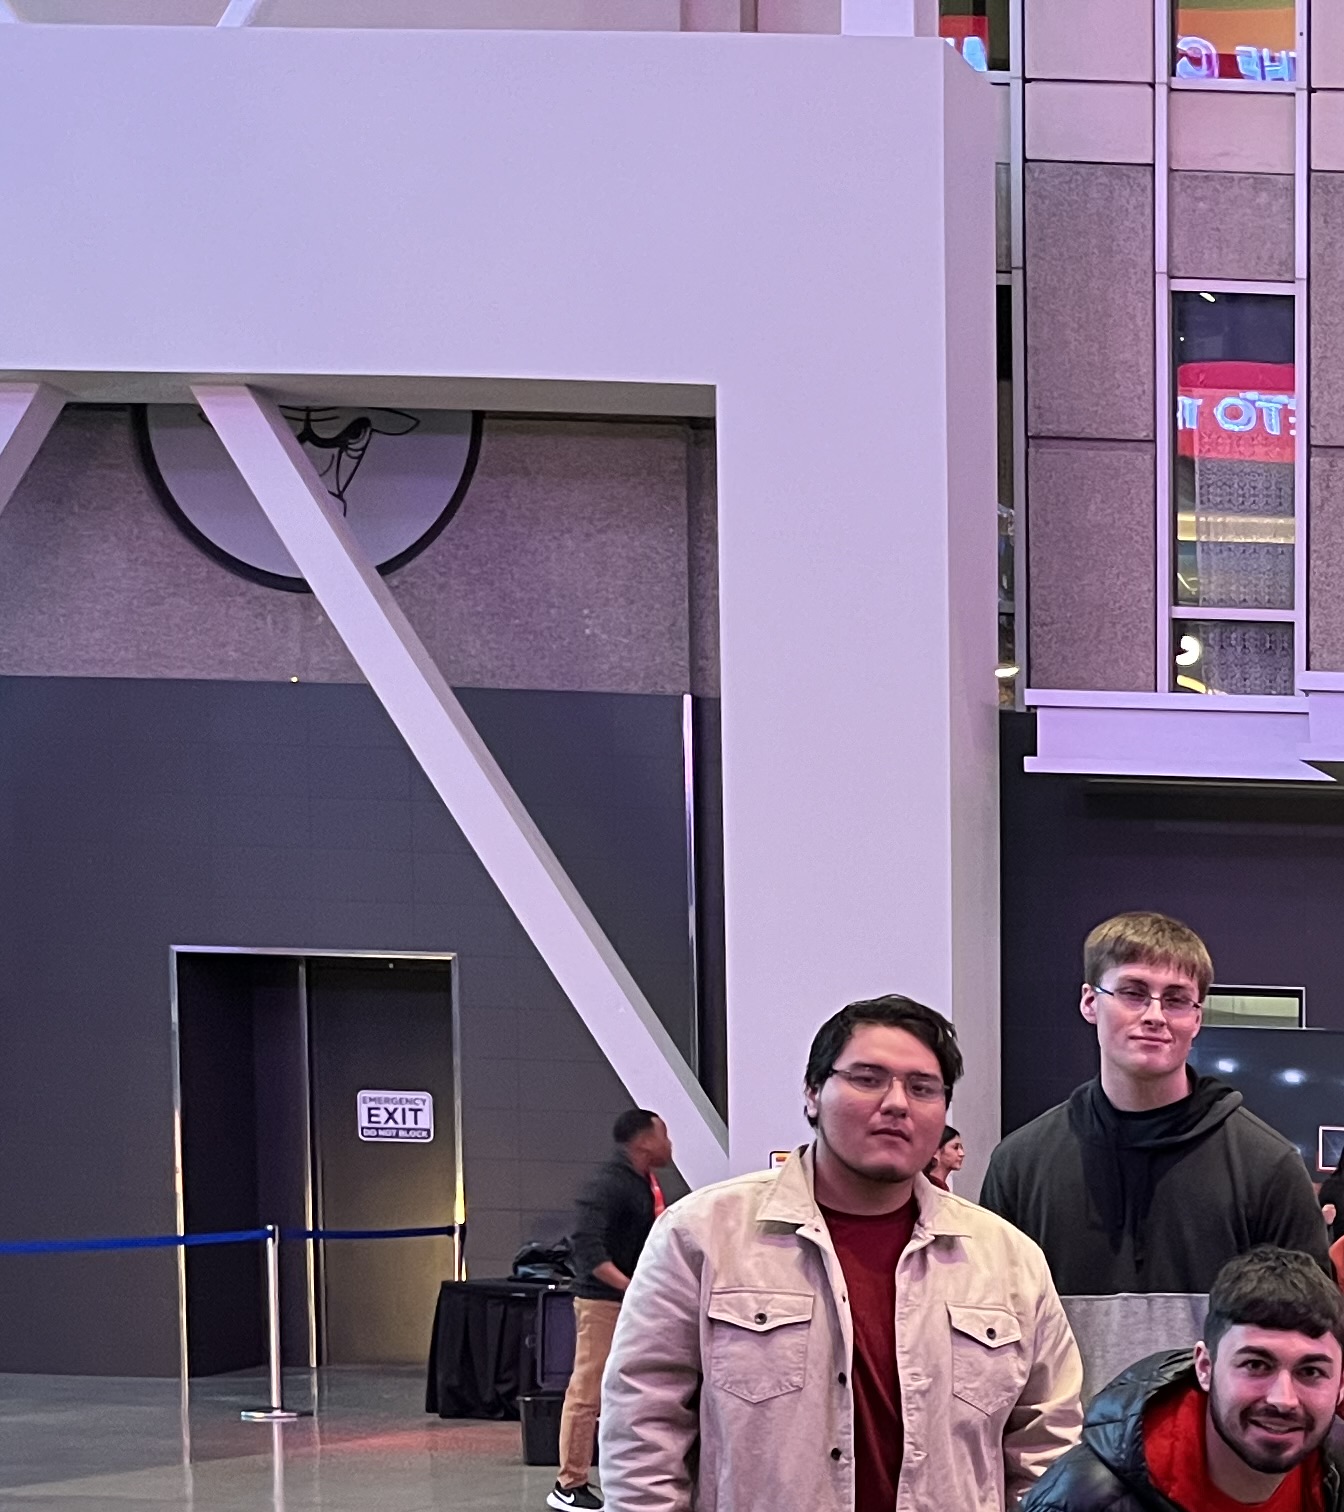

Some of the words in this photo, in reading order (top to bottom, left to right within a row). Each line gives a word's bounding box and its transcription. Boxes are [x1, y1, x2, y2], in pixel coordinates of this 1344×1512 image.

[362, 1096, 427, 1106] EMERGENCY
[367, 1106, 424, 1126] EXIT
[363, 1128, 377, 1136] DO
[378, 1129, 397, 1137] NOT
[398, 1129, 429, 1138] BLOCK
